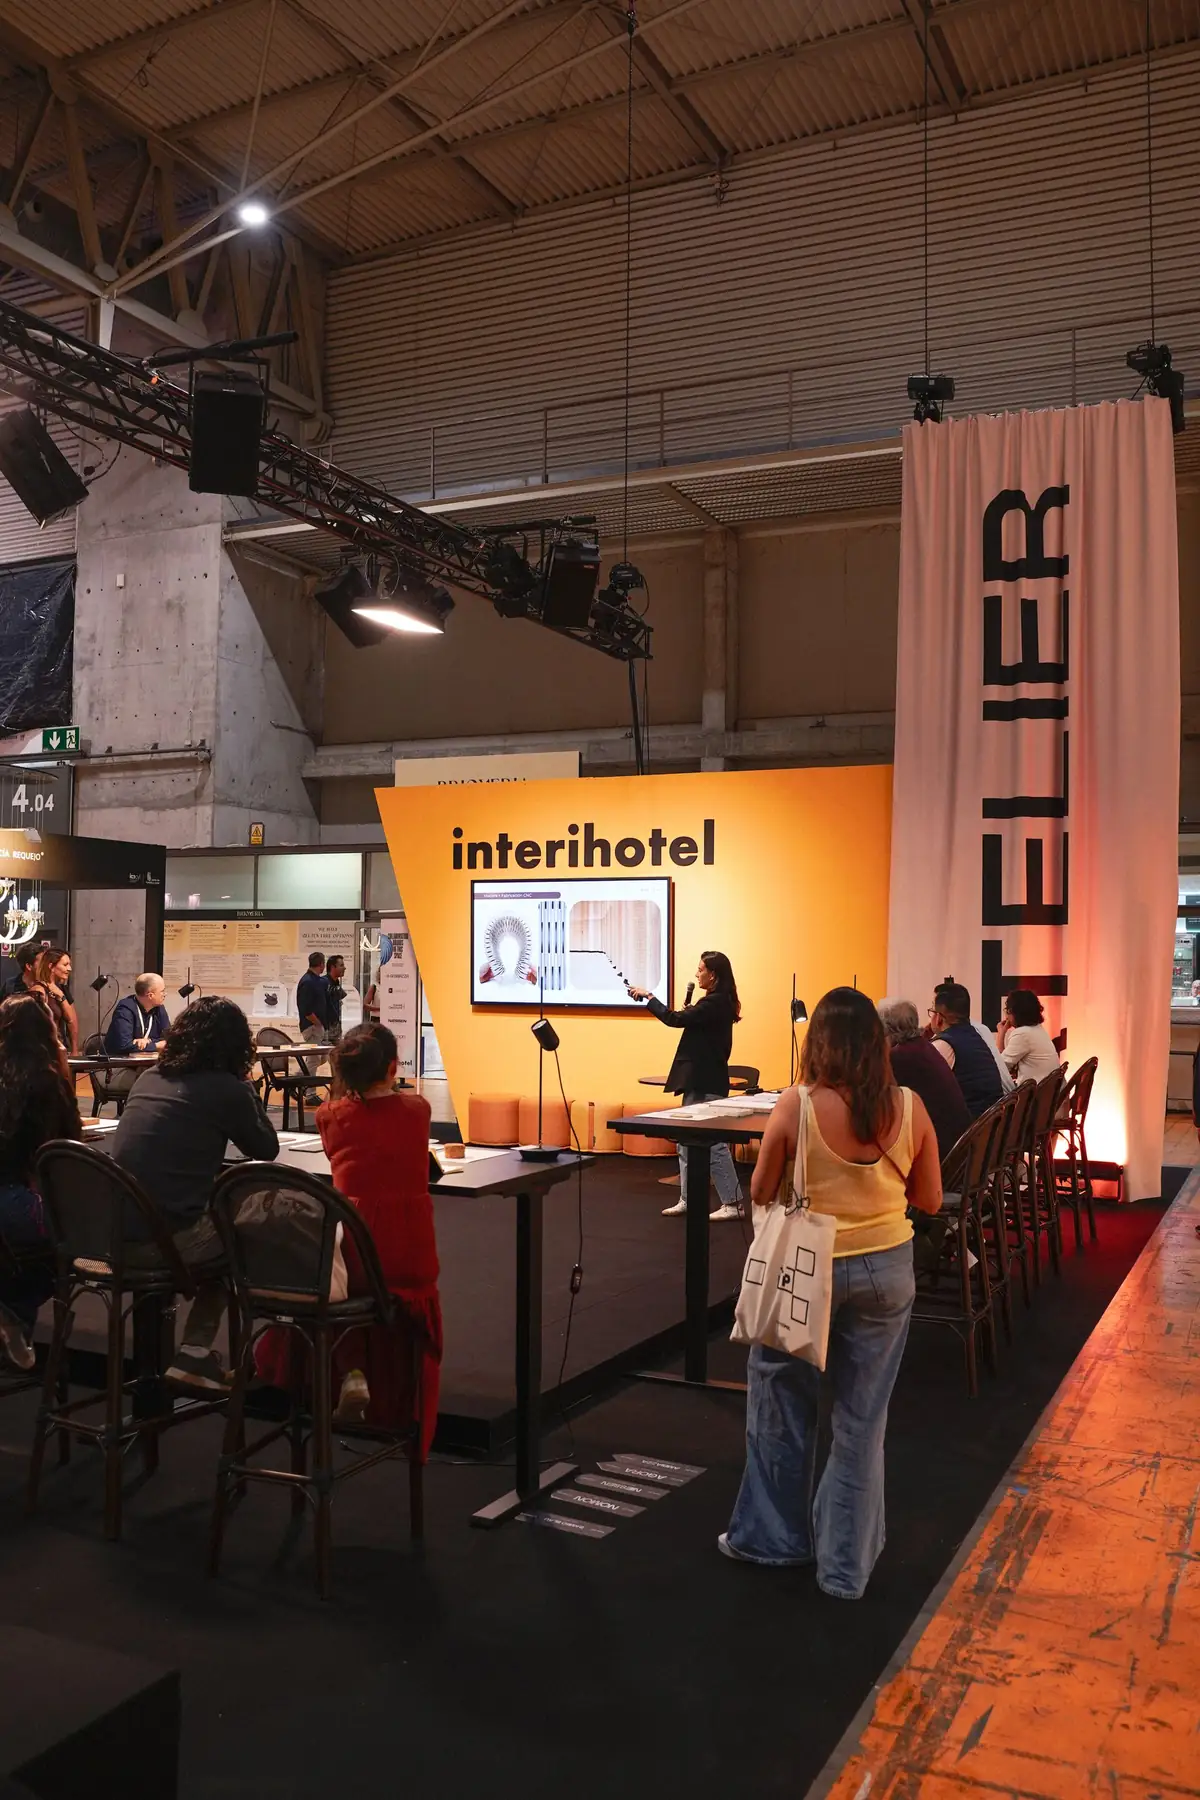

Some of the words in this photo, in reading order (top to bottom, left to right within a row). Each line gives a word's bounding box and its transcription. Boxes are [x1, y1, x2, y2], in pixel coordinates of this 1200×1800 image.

[982, 484, 1069, 1057] TELIER
[11, 784, 55, 813] 4.04
[452, 819, 715, 870] interihotel
[624, 1467, 668, 1480] AGORA
[575, 1495, 621, 1511] NOMON
